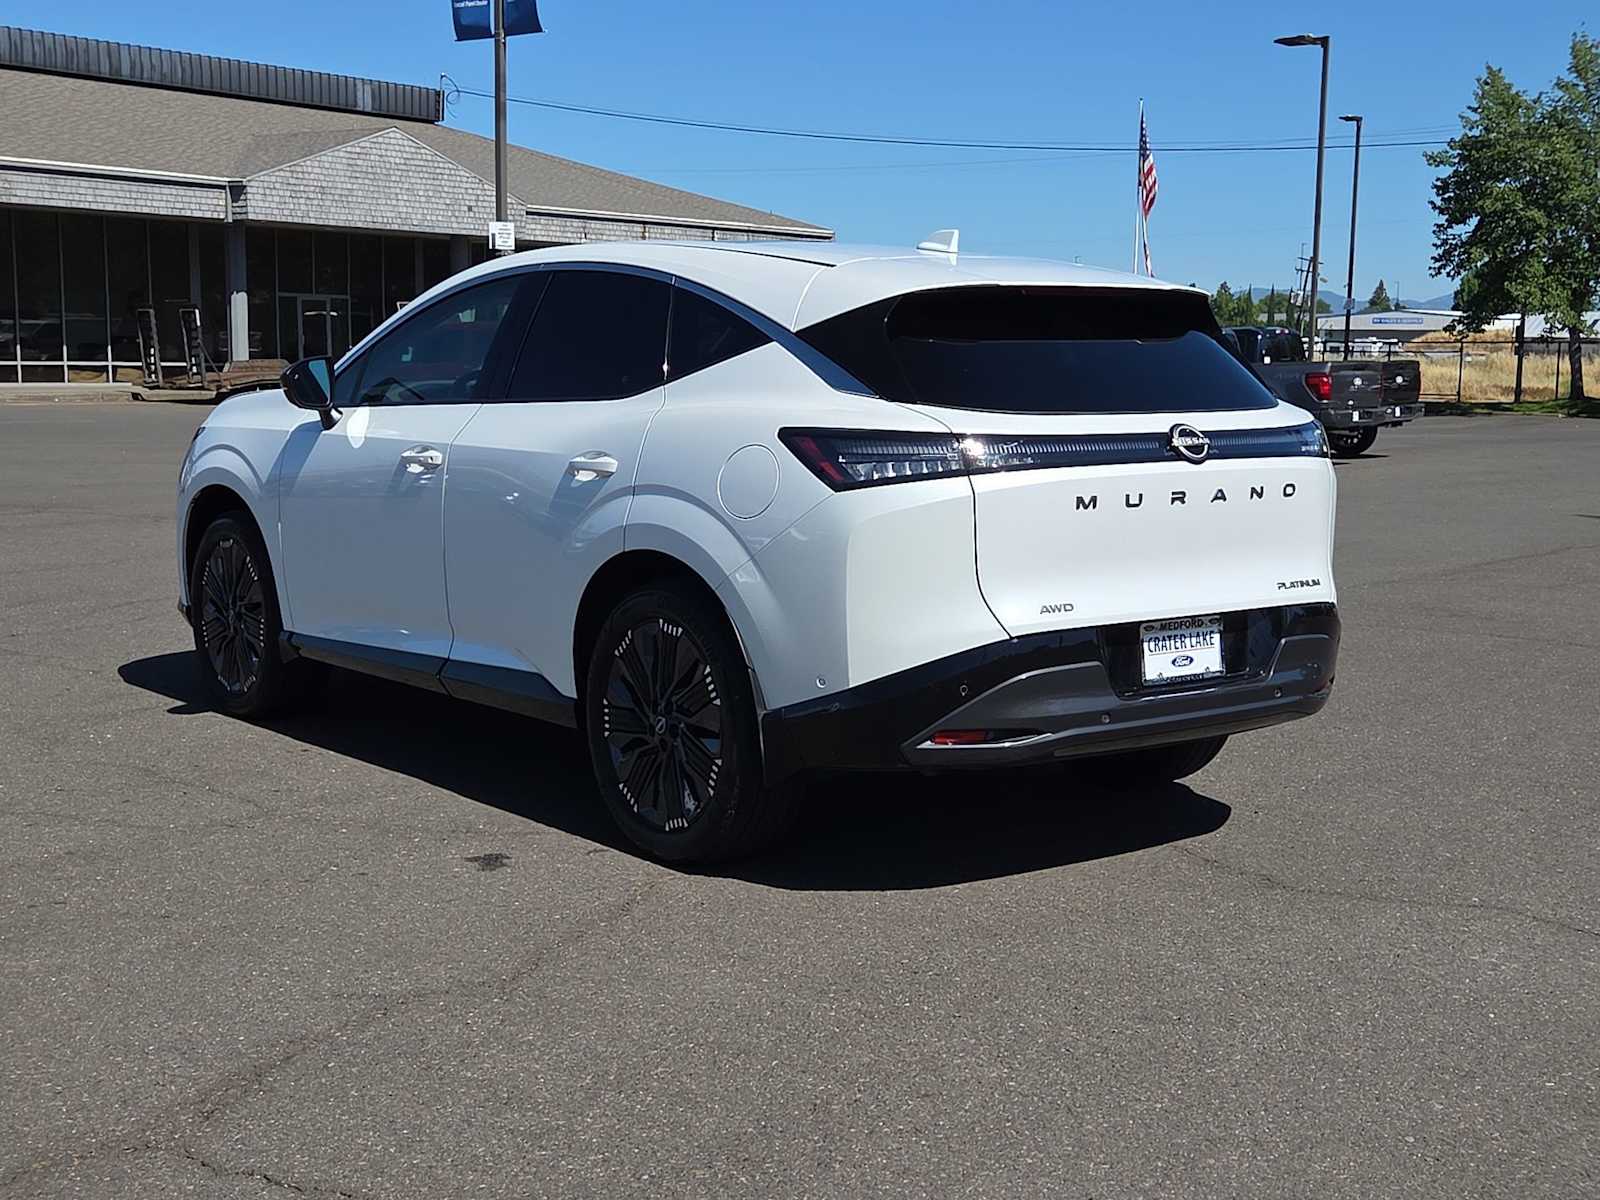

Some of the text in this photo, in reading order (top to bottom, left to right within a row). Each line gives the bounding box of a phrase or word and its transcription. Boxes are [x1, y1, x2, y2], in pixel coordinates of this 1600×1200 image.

[1171, 436, 1210, 447] NISSAN
[1075, 483, 1297, 510] MURANO
[1276, 578, 1321, 590] PLATINUM
[1039, 603, 1074, 615] AWD
[1160, 618, 1204, 631] MEDFORD
[1147, 630, 1216, 653] CRATER LAKE
